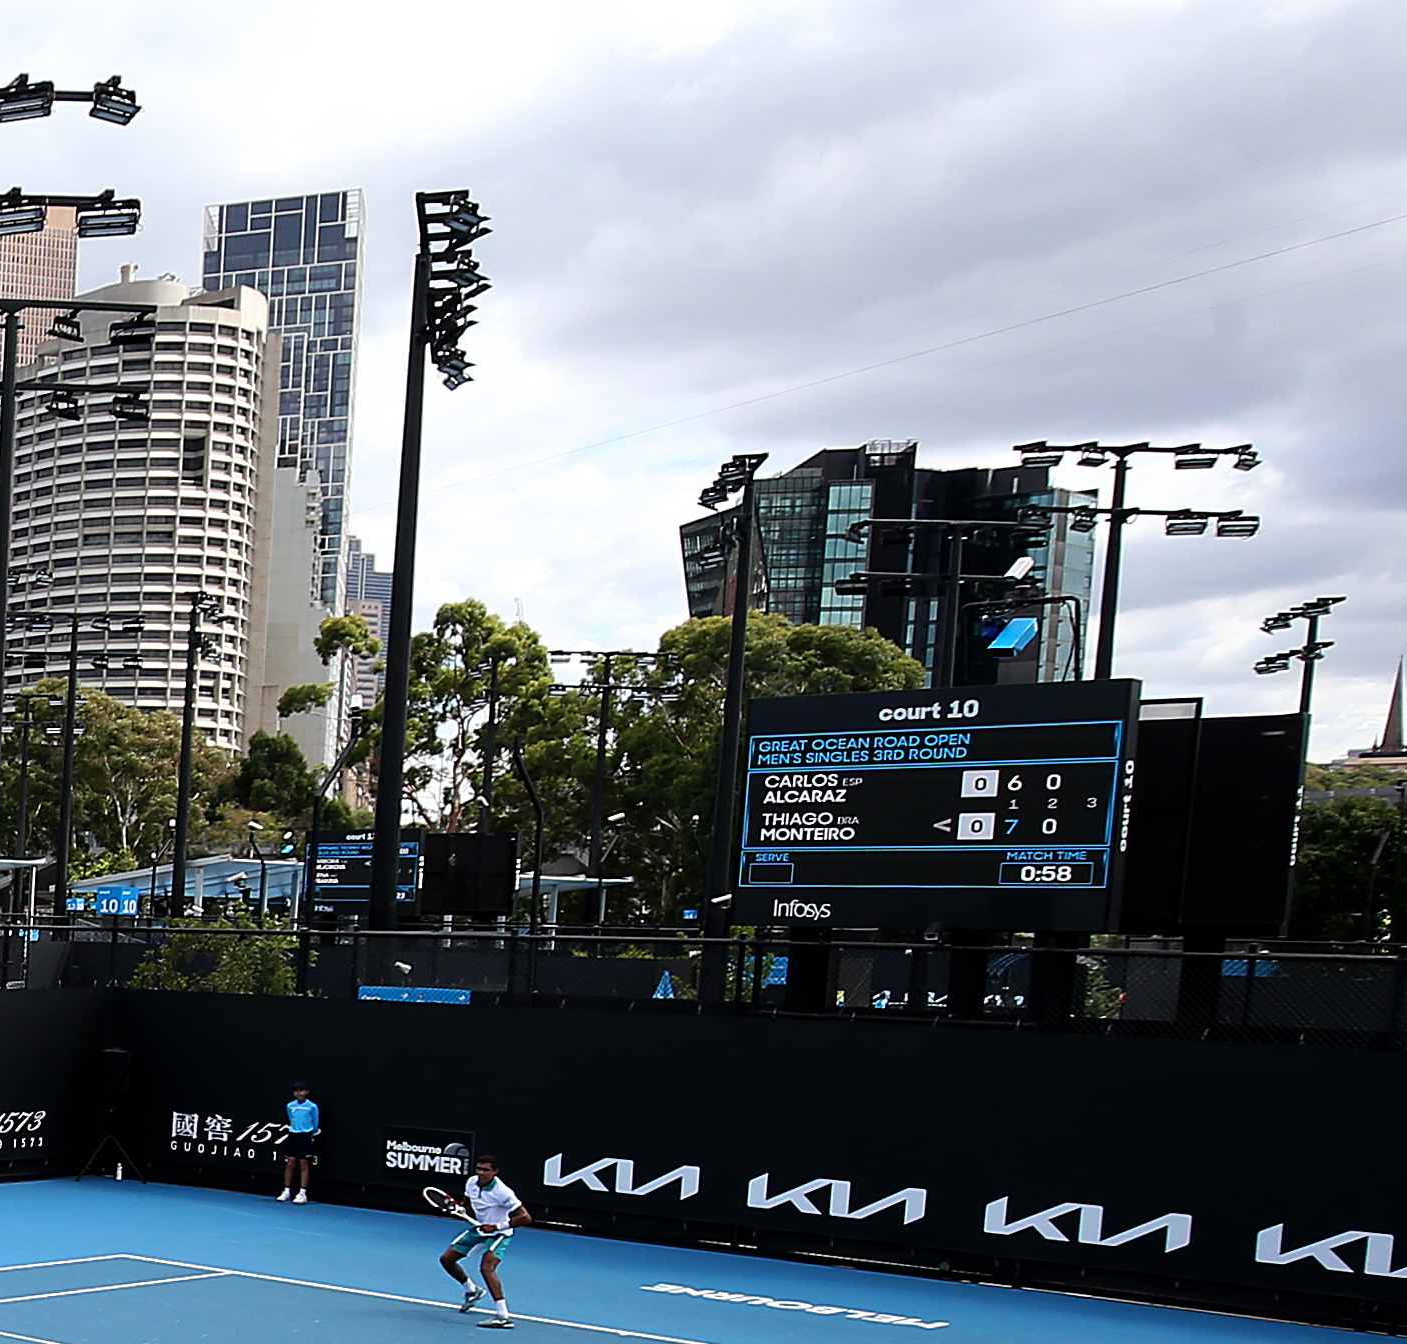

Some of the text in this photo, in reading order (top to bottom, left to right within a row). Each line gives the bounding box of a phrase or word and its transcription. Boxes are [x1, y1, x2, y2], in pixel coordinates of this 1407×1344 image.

[879, 699, 979, 721] court 10
[758, 733, 971, 752] GREAT OCEAN ROAD OPEN
[757, 746, 968, 765] MEN'S SINGLES 3RD ROUND
[764, 774, 863, 788] CARLOS ESP
[973, 773, 1061, 792] 0 6 0
[763, 789, 847, 804] ALCARAZ
[1047, 798, 1059, 809] 2
[1087, 797, 1098, 808] 3
[762, 812, 834, 826] THIAGO
[969, 818, 1058, 835] 0 7 0
[760, 827, 856, 841] MONTEIRO
[755, 851, 1087, 862] SERVE MATCH TIME
[1020, 866, 1072, 882] 0:58
[100, 899, 119, 913] 10
[123, 899, 137, 913] 10
[773, 899, 831, 920] Infosys
[170, 1140, 255, 1159] GUOJIAO
[386, 1140, 442, 1155] Melbourne
[385, 1151, 462, 1175] SUMMER
[1255, 1223, 1407, 1279] KI
[640, 1282, 950, 1330] MELBOURNE
